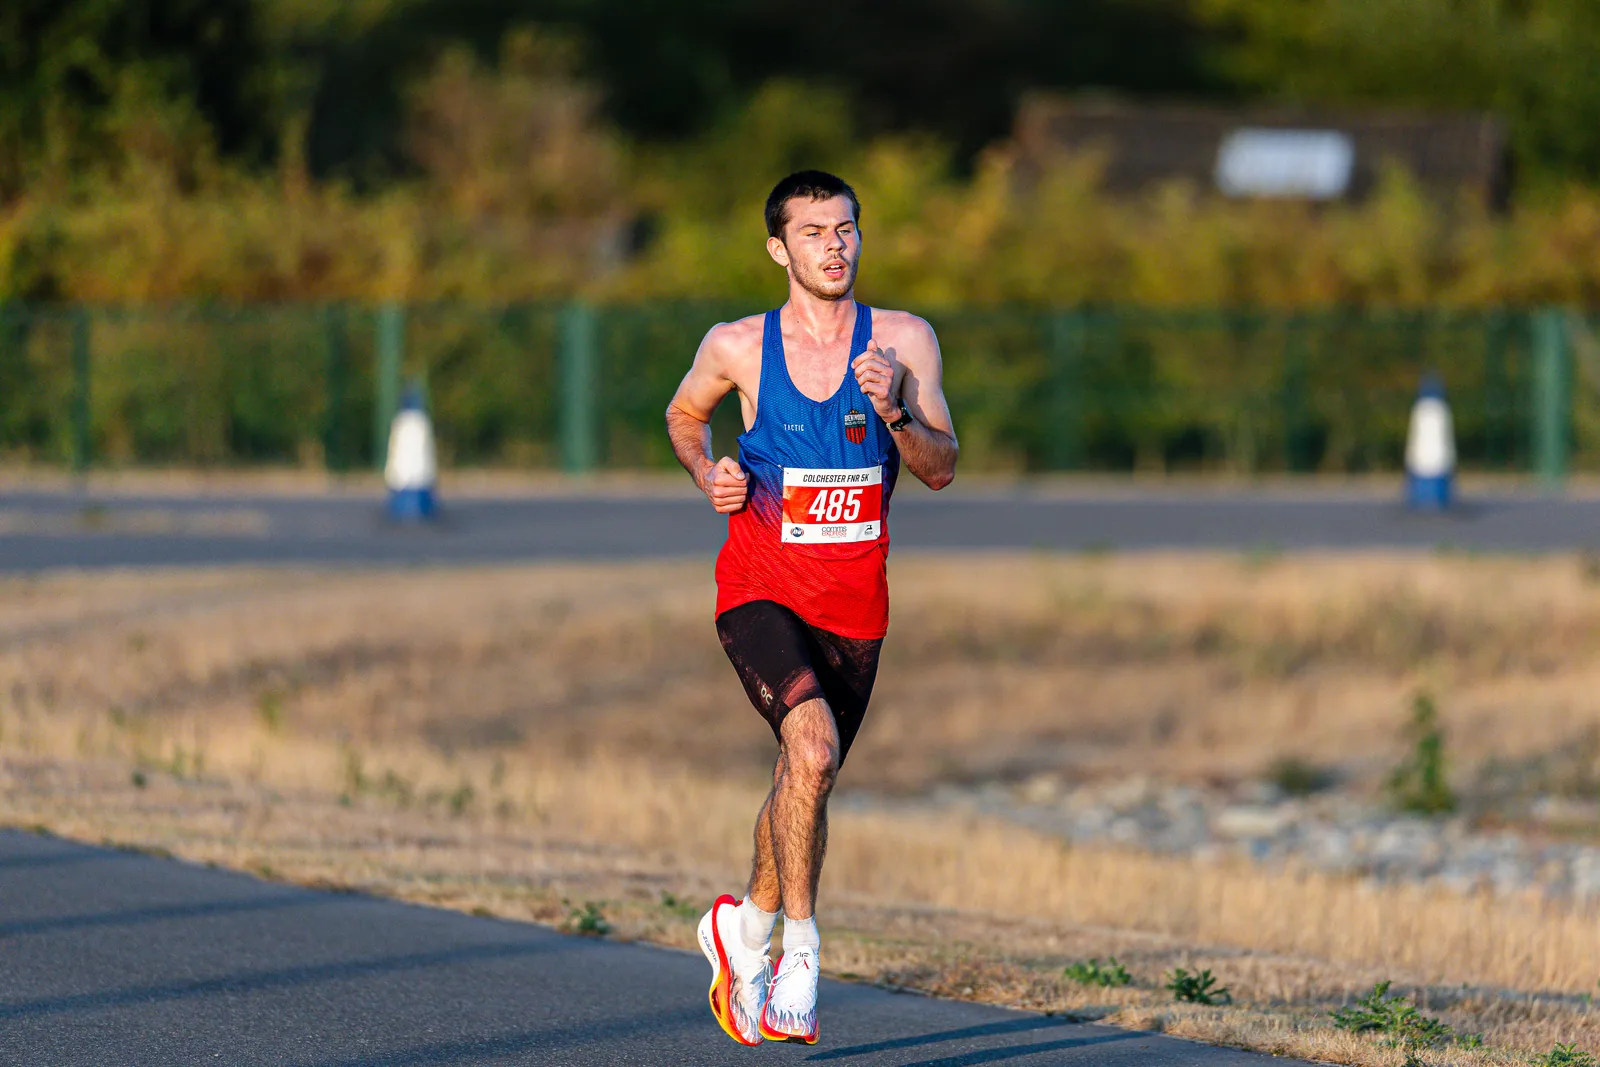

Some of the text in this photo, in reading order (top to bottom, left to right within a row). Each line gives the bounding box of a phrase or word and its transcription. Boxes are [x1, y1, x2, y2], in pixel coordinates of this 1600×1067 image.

[803, 474, 869, 483] COLCHESTER FNR 5K
[808, 489, 863, 522] 485
